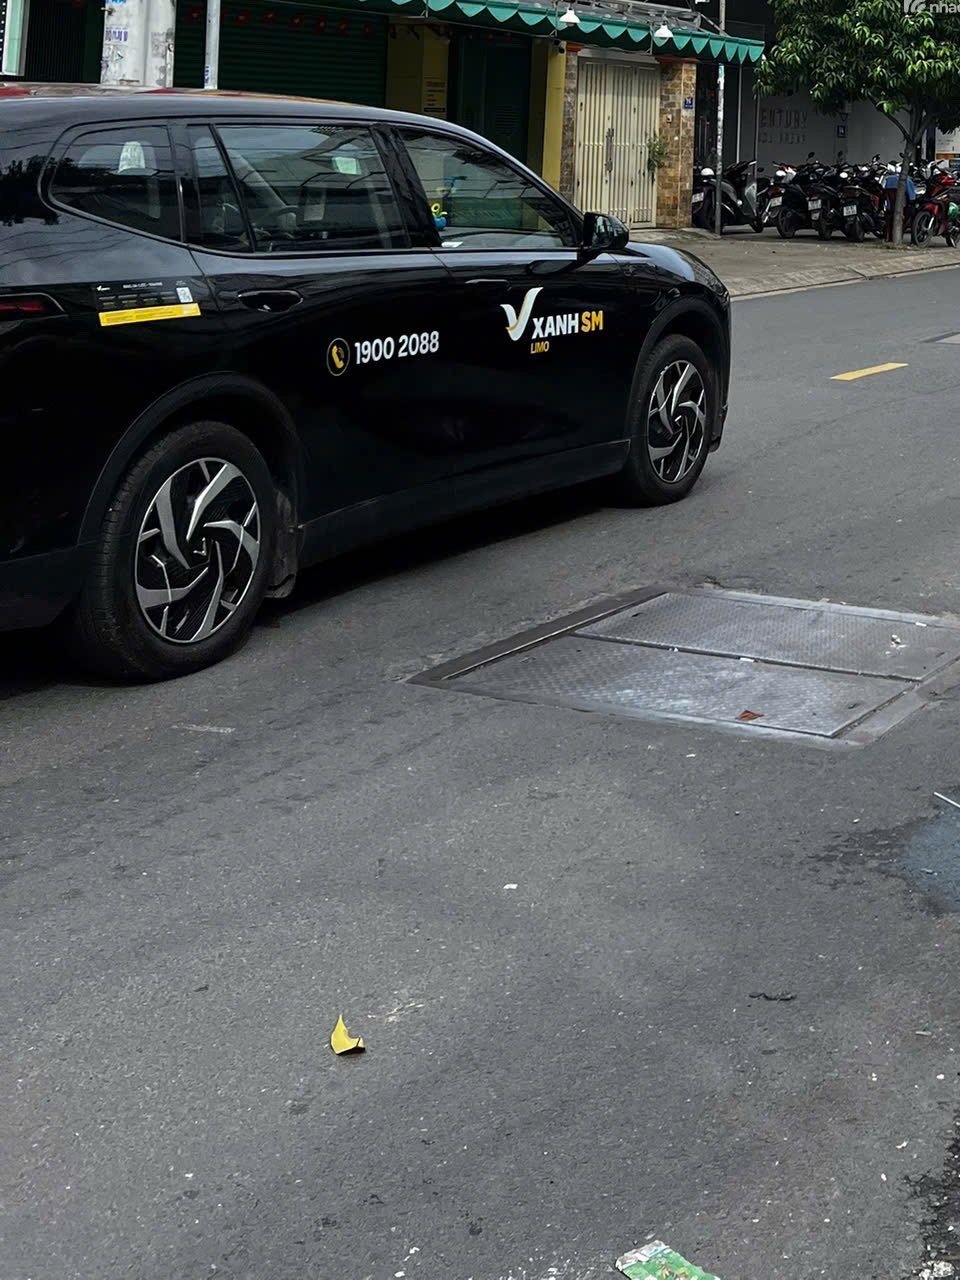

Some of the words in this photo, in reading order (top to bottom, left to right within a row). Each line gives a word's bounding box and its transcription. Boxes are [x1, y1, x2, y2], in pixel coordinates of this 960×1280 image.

[531, 311, 579, 340] XANH
[580, 310, 604, 334] SM
[354, 336, 395, 365] 1900
[398, 330, 440, 358] 2088
[530, 340, 550, 354] LIMO
